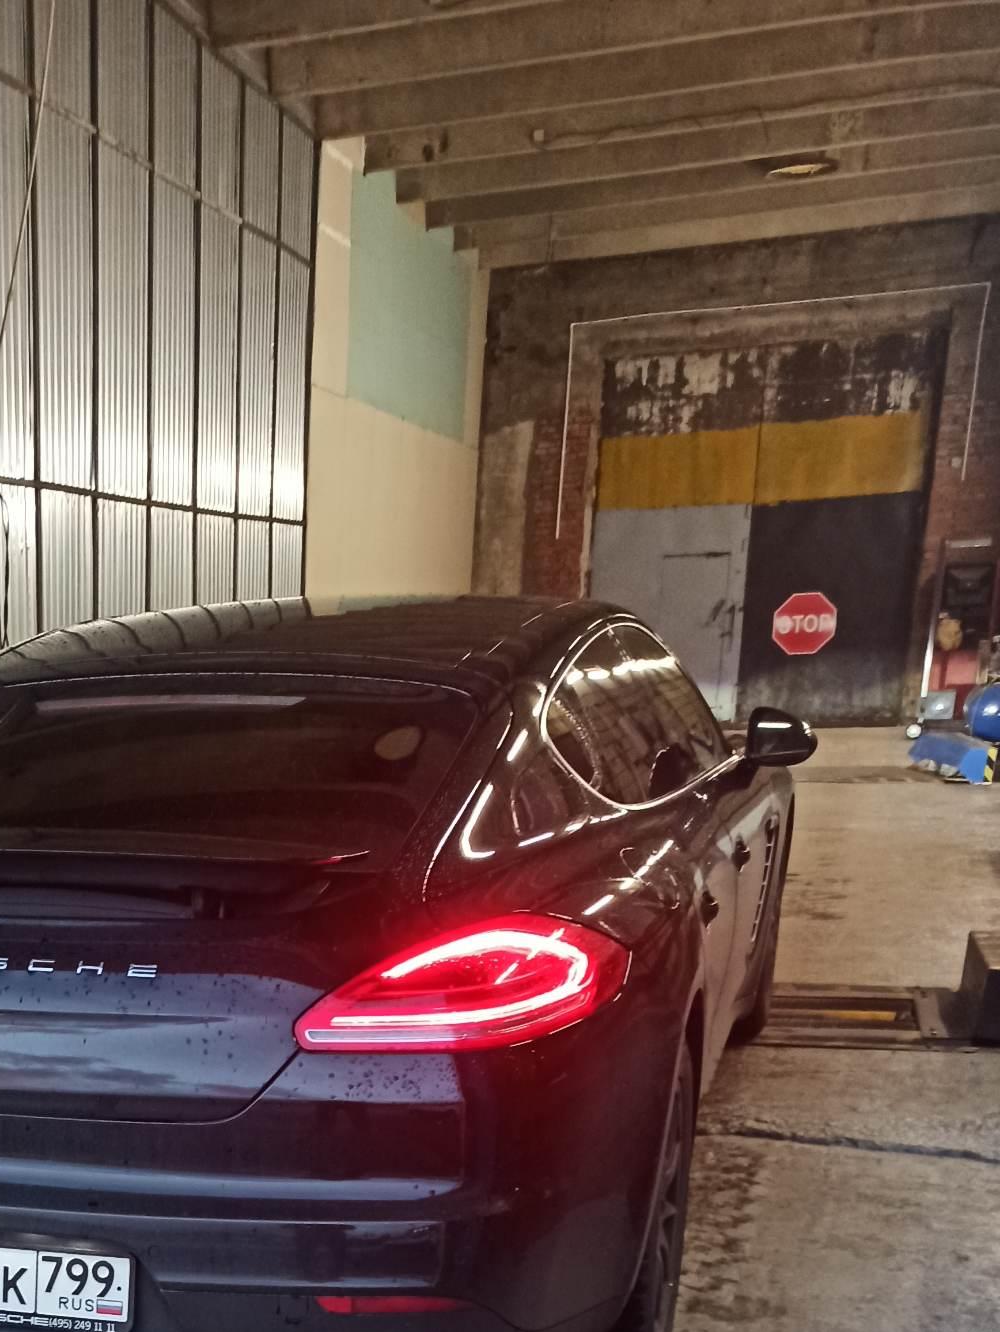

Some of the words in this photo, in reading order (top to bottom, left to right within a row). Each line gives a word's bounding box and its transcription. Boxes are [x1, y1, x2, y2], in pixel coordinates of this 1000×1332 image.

[41, 1256, 115, 1297] 799
[58, 1297, 94, 1312] RUS
[49, 1317, 72, 1330] (495)
[74, 1320, 92, 1331] 249
